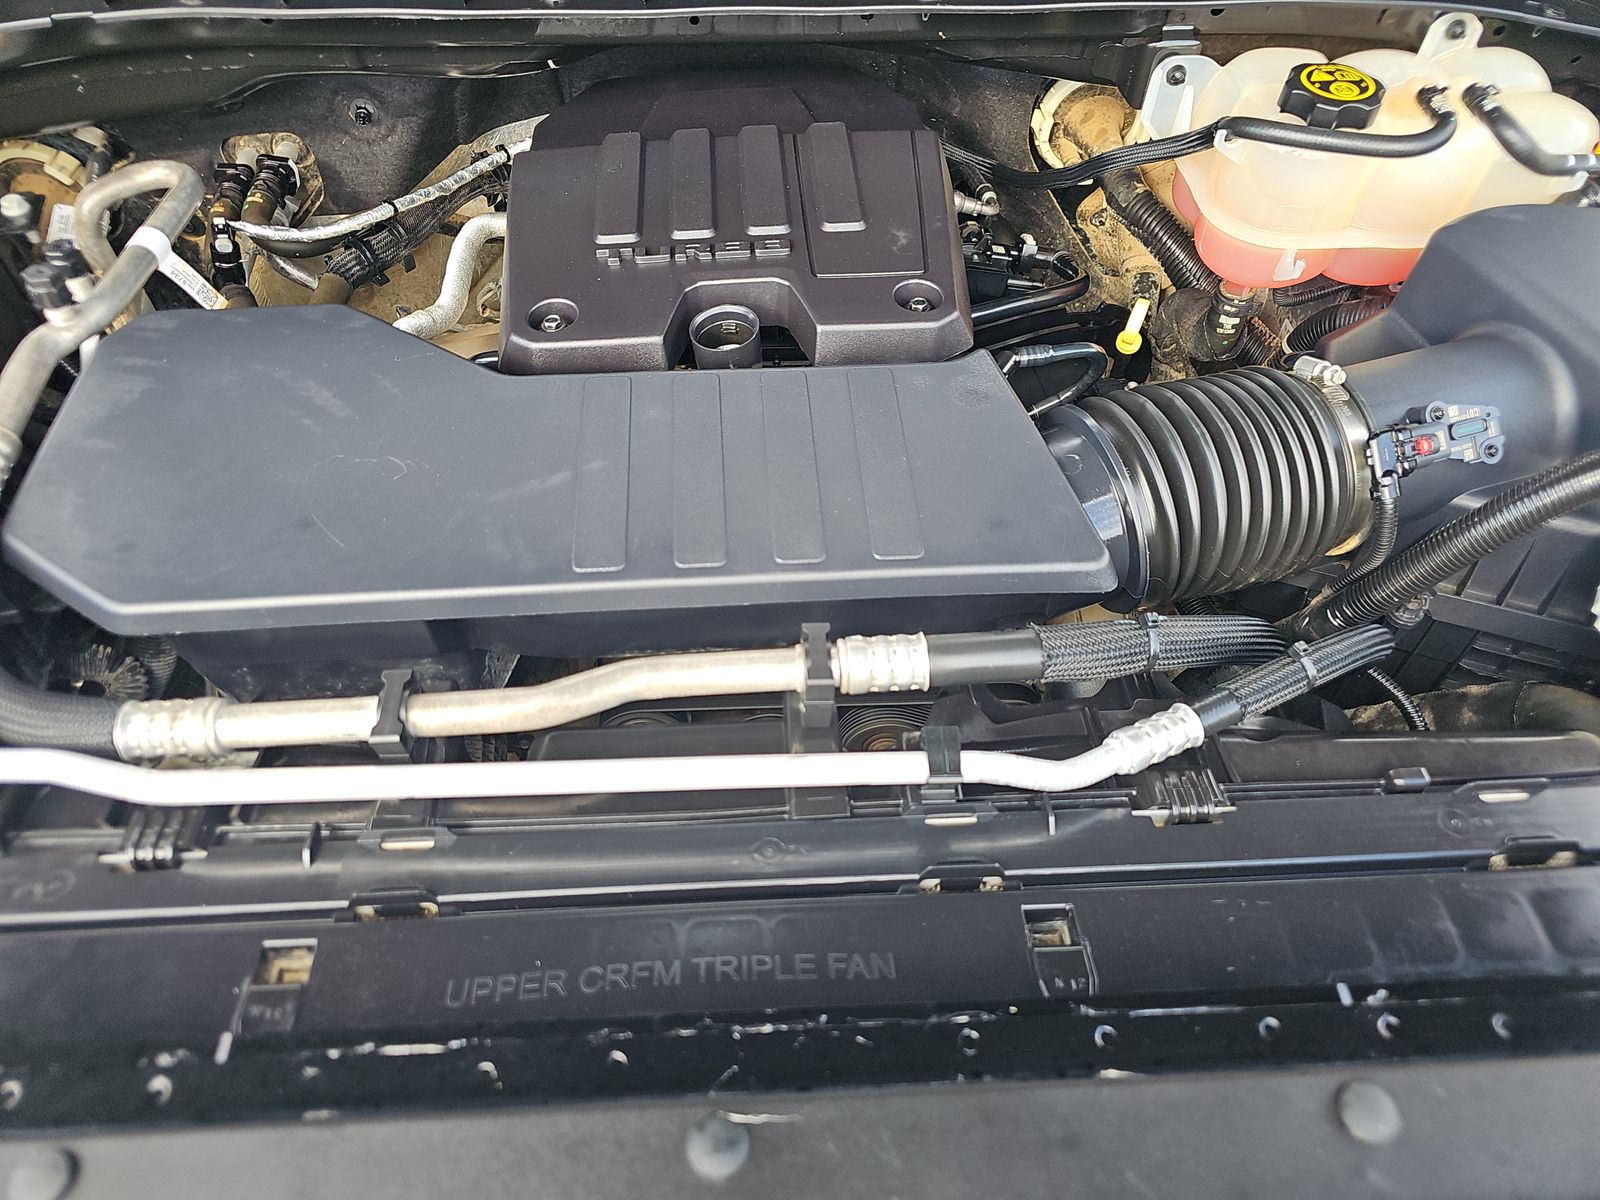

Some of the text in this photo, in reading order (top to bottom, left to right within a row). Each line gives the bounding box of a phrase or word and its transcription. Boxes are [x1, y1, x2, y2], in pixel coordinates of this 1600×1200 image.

[595, 239, 791, 266] TURBO
[444, 951, 898, 1009] UPPER CRFM TRIPLE FAN
